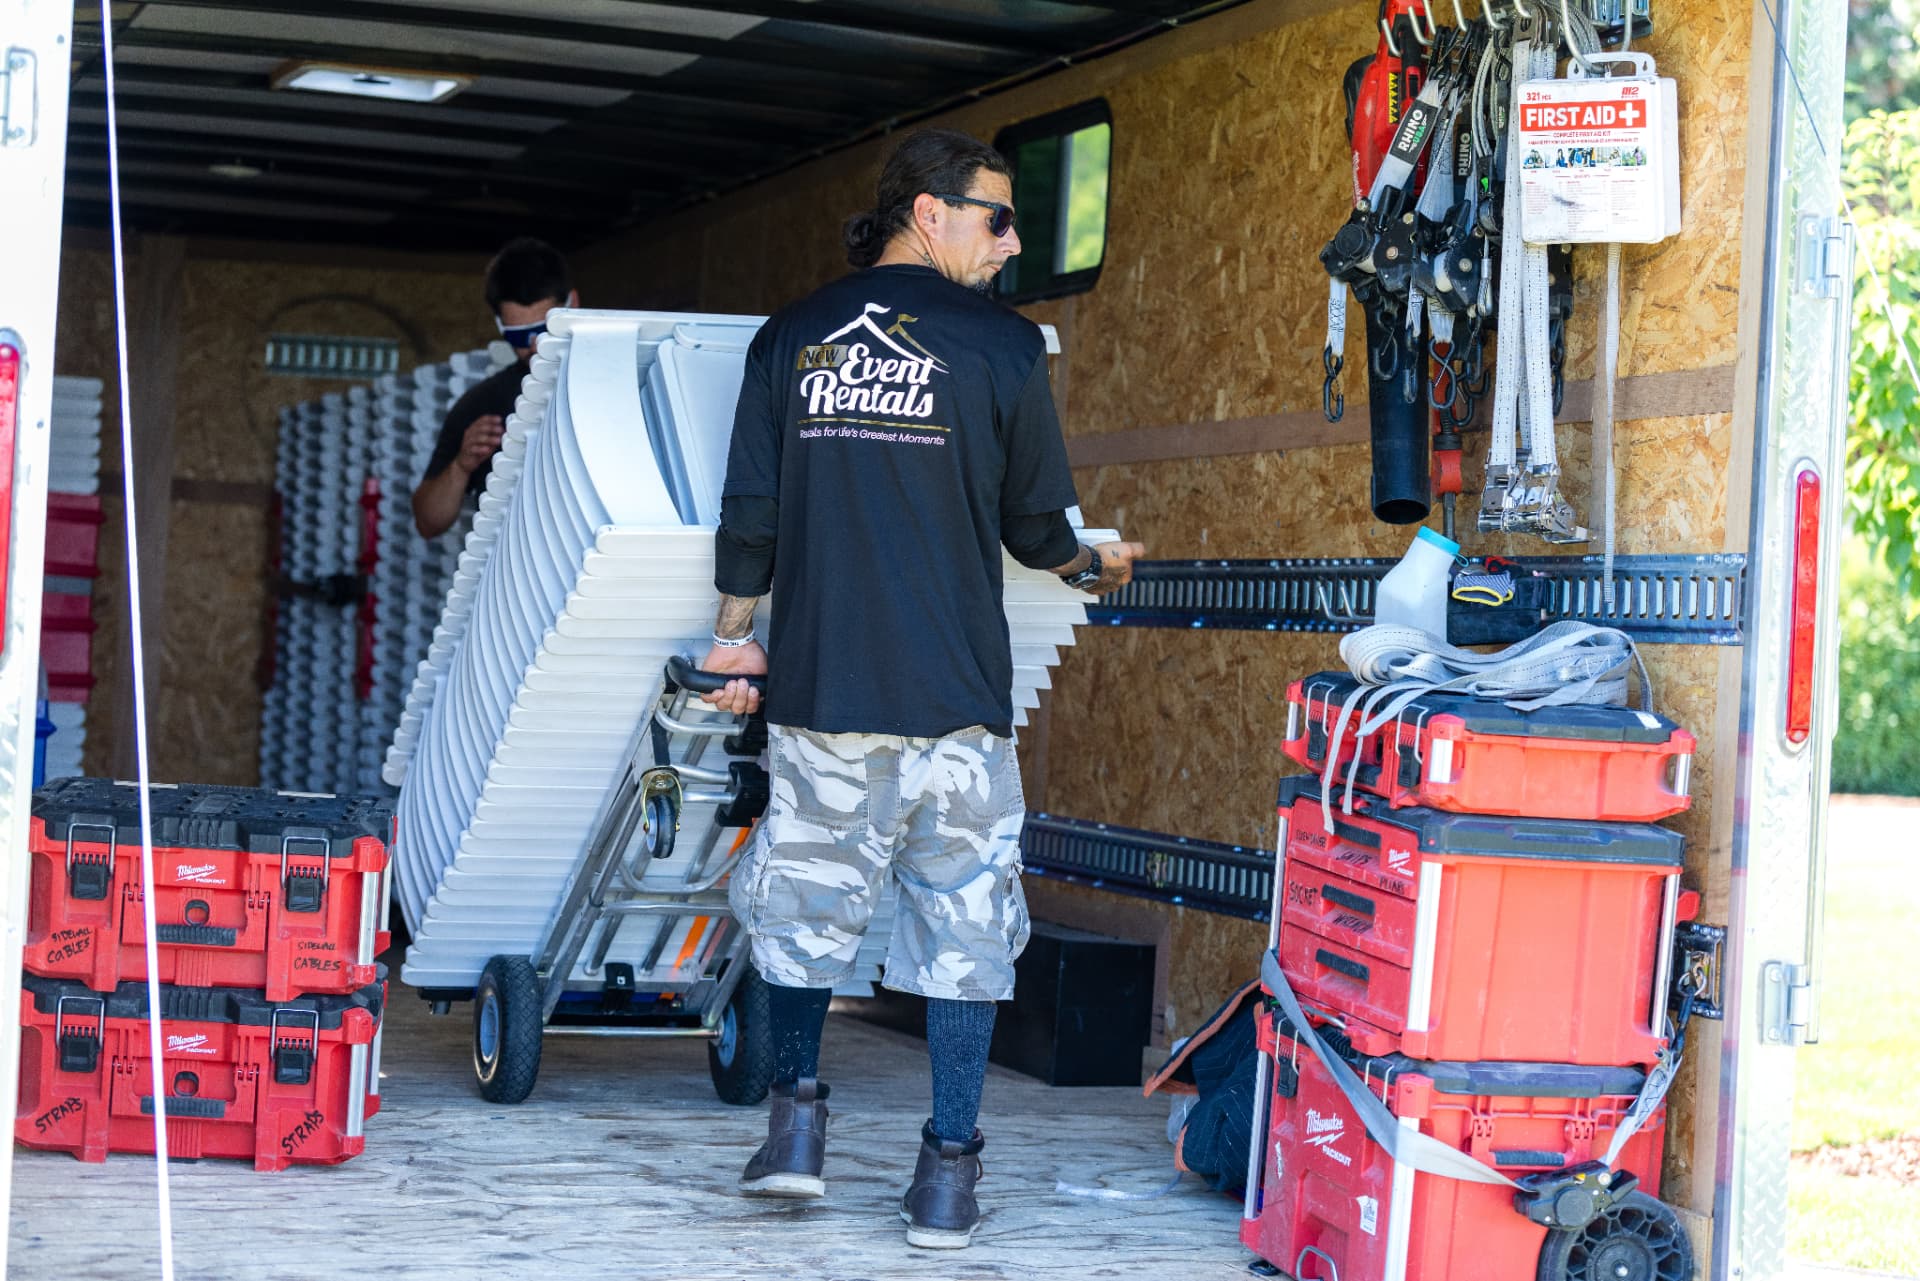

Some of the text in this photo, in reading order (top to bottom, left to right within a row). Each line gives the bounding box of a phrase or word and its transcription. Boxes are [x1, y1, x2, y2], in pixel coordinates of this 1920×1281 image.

[1526, 92, 1541, 101] 321
[1526, 106, 1580, 127] FIRST
[1582, 105, 1616, 126] AID
[1398, 109, 1423, 152] RHINO
[1458, 132, 1471, 176] RHINO
[840, 343, 934, 385] Event
[800, 370, 934, 418] Rentals
[823, 425, 838, 437] for
[859, 429, 897, 442] Greatest
[898, 433, 946, 446] Moments
[294, 956, 342, 971] CABLES
[35, 1096, 83, 1134] STRAPS
[281, 1109, 324, 1155] STRAPS
